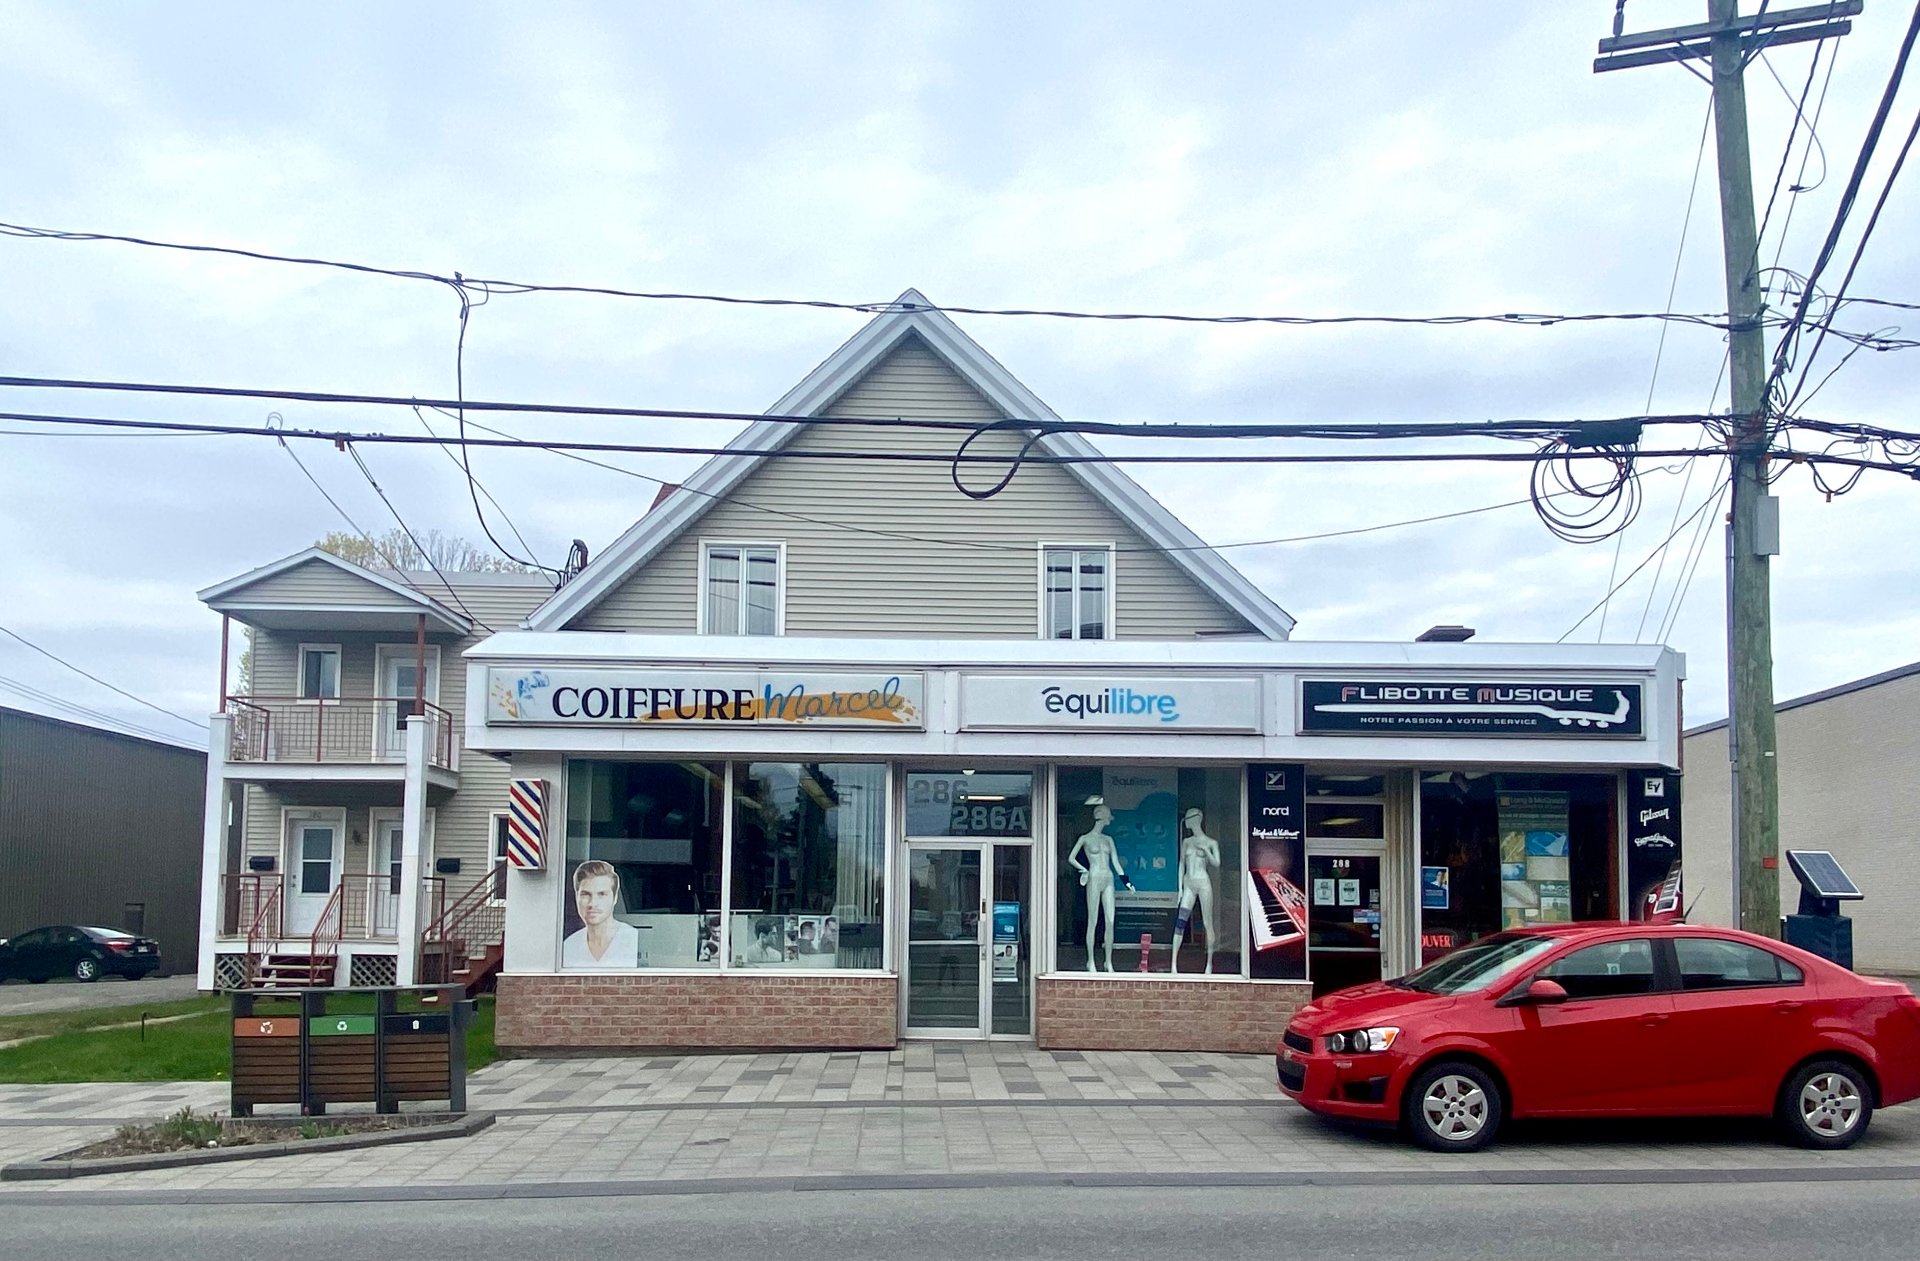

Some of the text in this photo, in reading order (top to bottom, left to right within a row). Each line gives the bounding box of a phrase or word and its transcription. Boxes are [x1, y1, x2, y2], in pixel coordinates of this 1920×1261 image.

[552, 676, 902, 721] COIFFURE Marcel
[1341, 686, 1594, 703] FLIBOTTE MUSIQUE
[913, 779, 969, 804] 286
[1647, 780, 1661, 793] EV
[951, 805, 1028, 831] 286A
[1262, 806, 1290, 816] nord
[1332, 859, 1350, 868] 288
